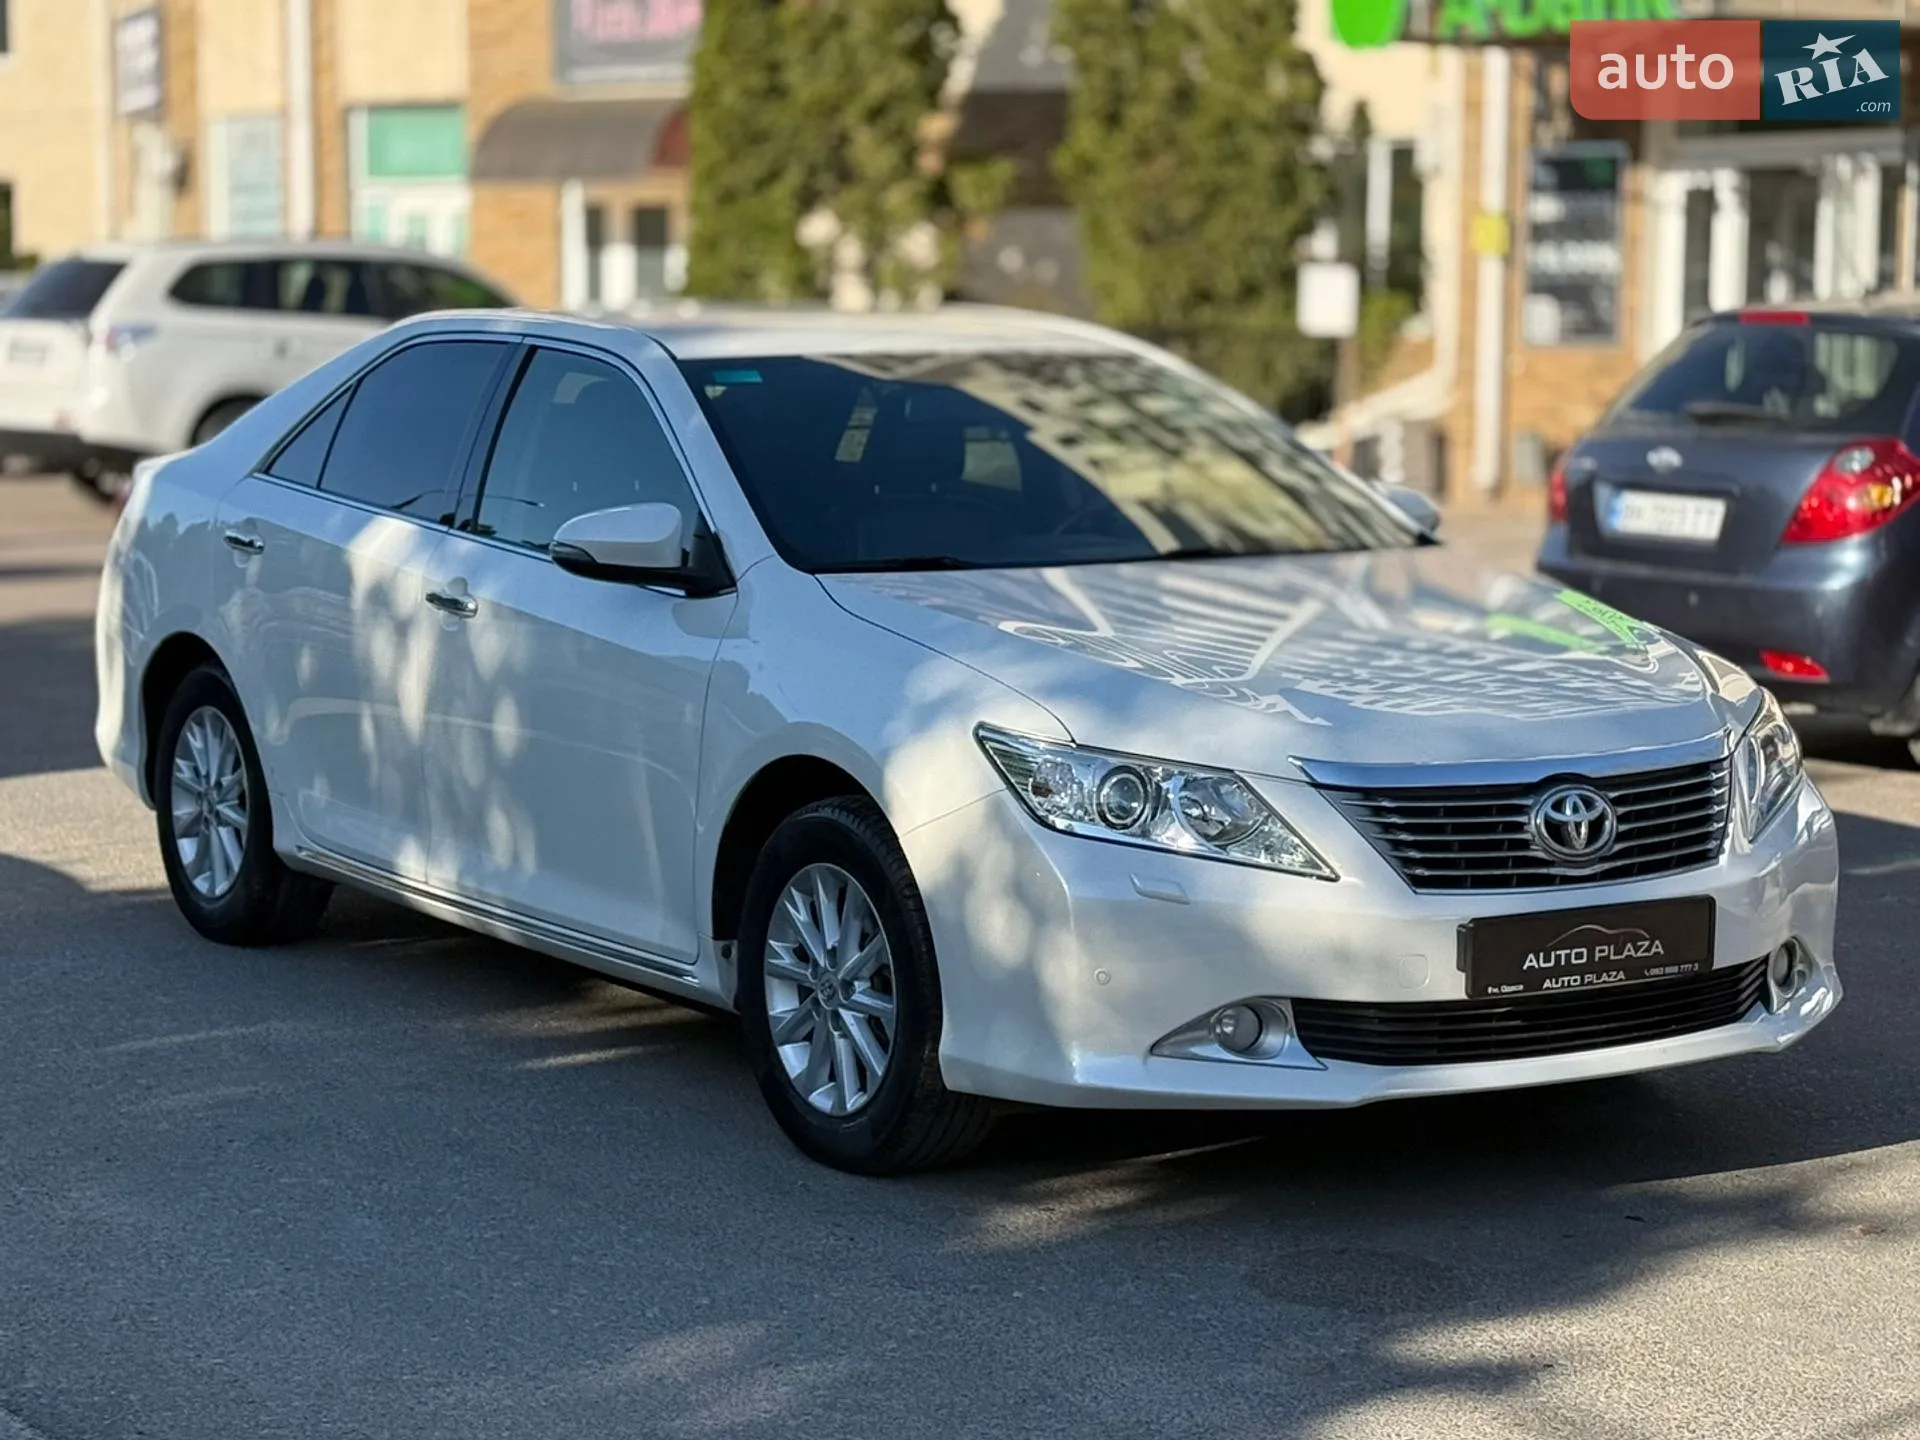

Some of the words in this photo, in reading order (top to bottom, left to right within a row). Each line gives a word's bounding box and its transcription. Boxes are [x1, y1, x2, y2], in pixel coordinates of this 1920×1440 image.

[1522, 948, 1587, 970] AUTO
[1595, 939, 1665, 962] PLAZA
[1542, 975, 1581, 990] AUTO
[1584, 970, 1626, 985] PLAZA
